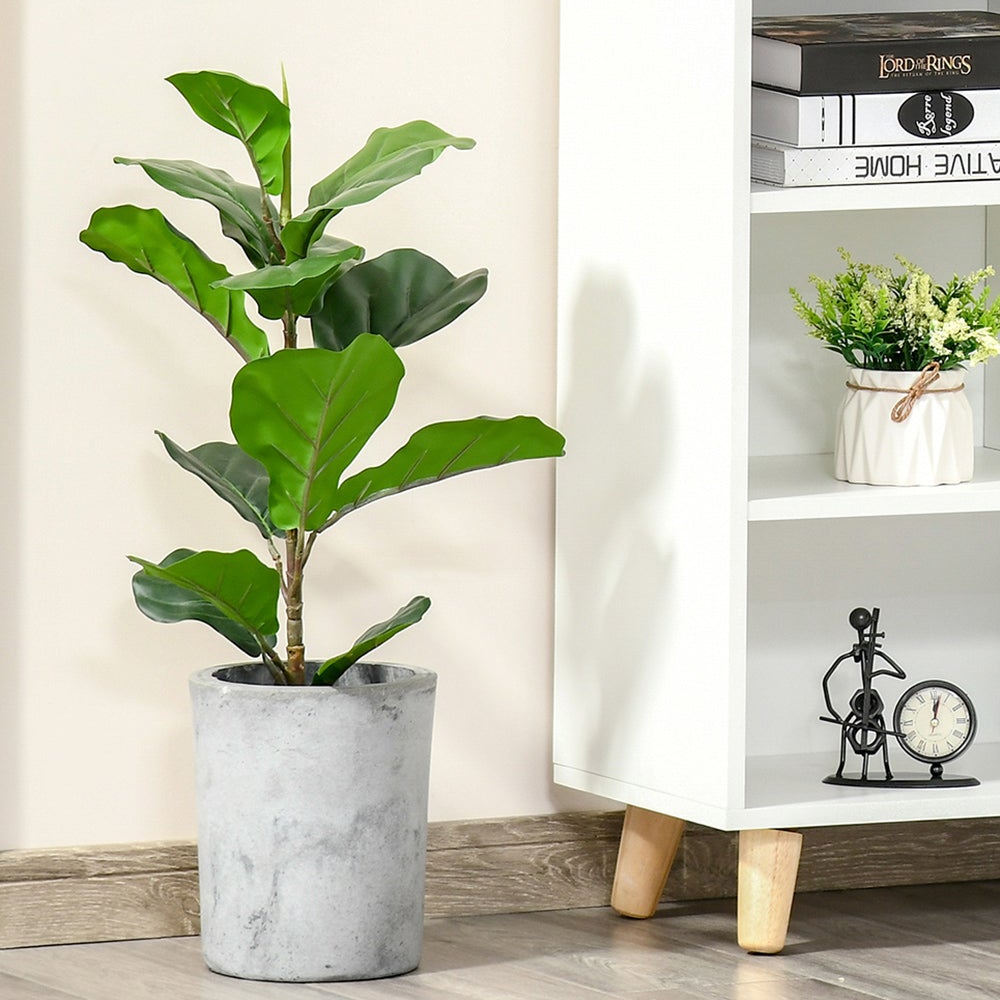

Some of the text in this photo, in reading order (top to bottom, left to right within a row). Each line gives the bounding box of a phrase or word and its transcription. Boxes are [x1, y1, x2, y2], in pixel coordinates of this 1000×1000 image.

[879, 55, 915, 79] LORD
[926, 54, 972, 75] RINGS
[855, 154, 922, 178] HOME
